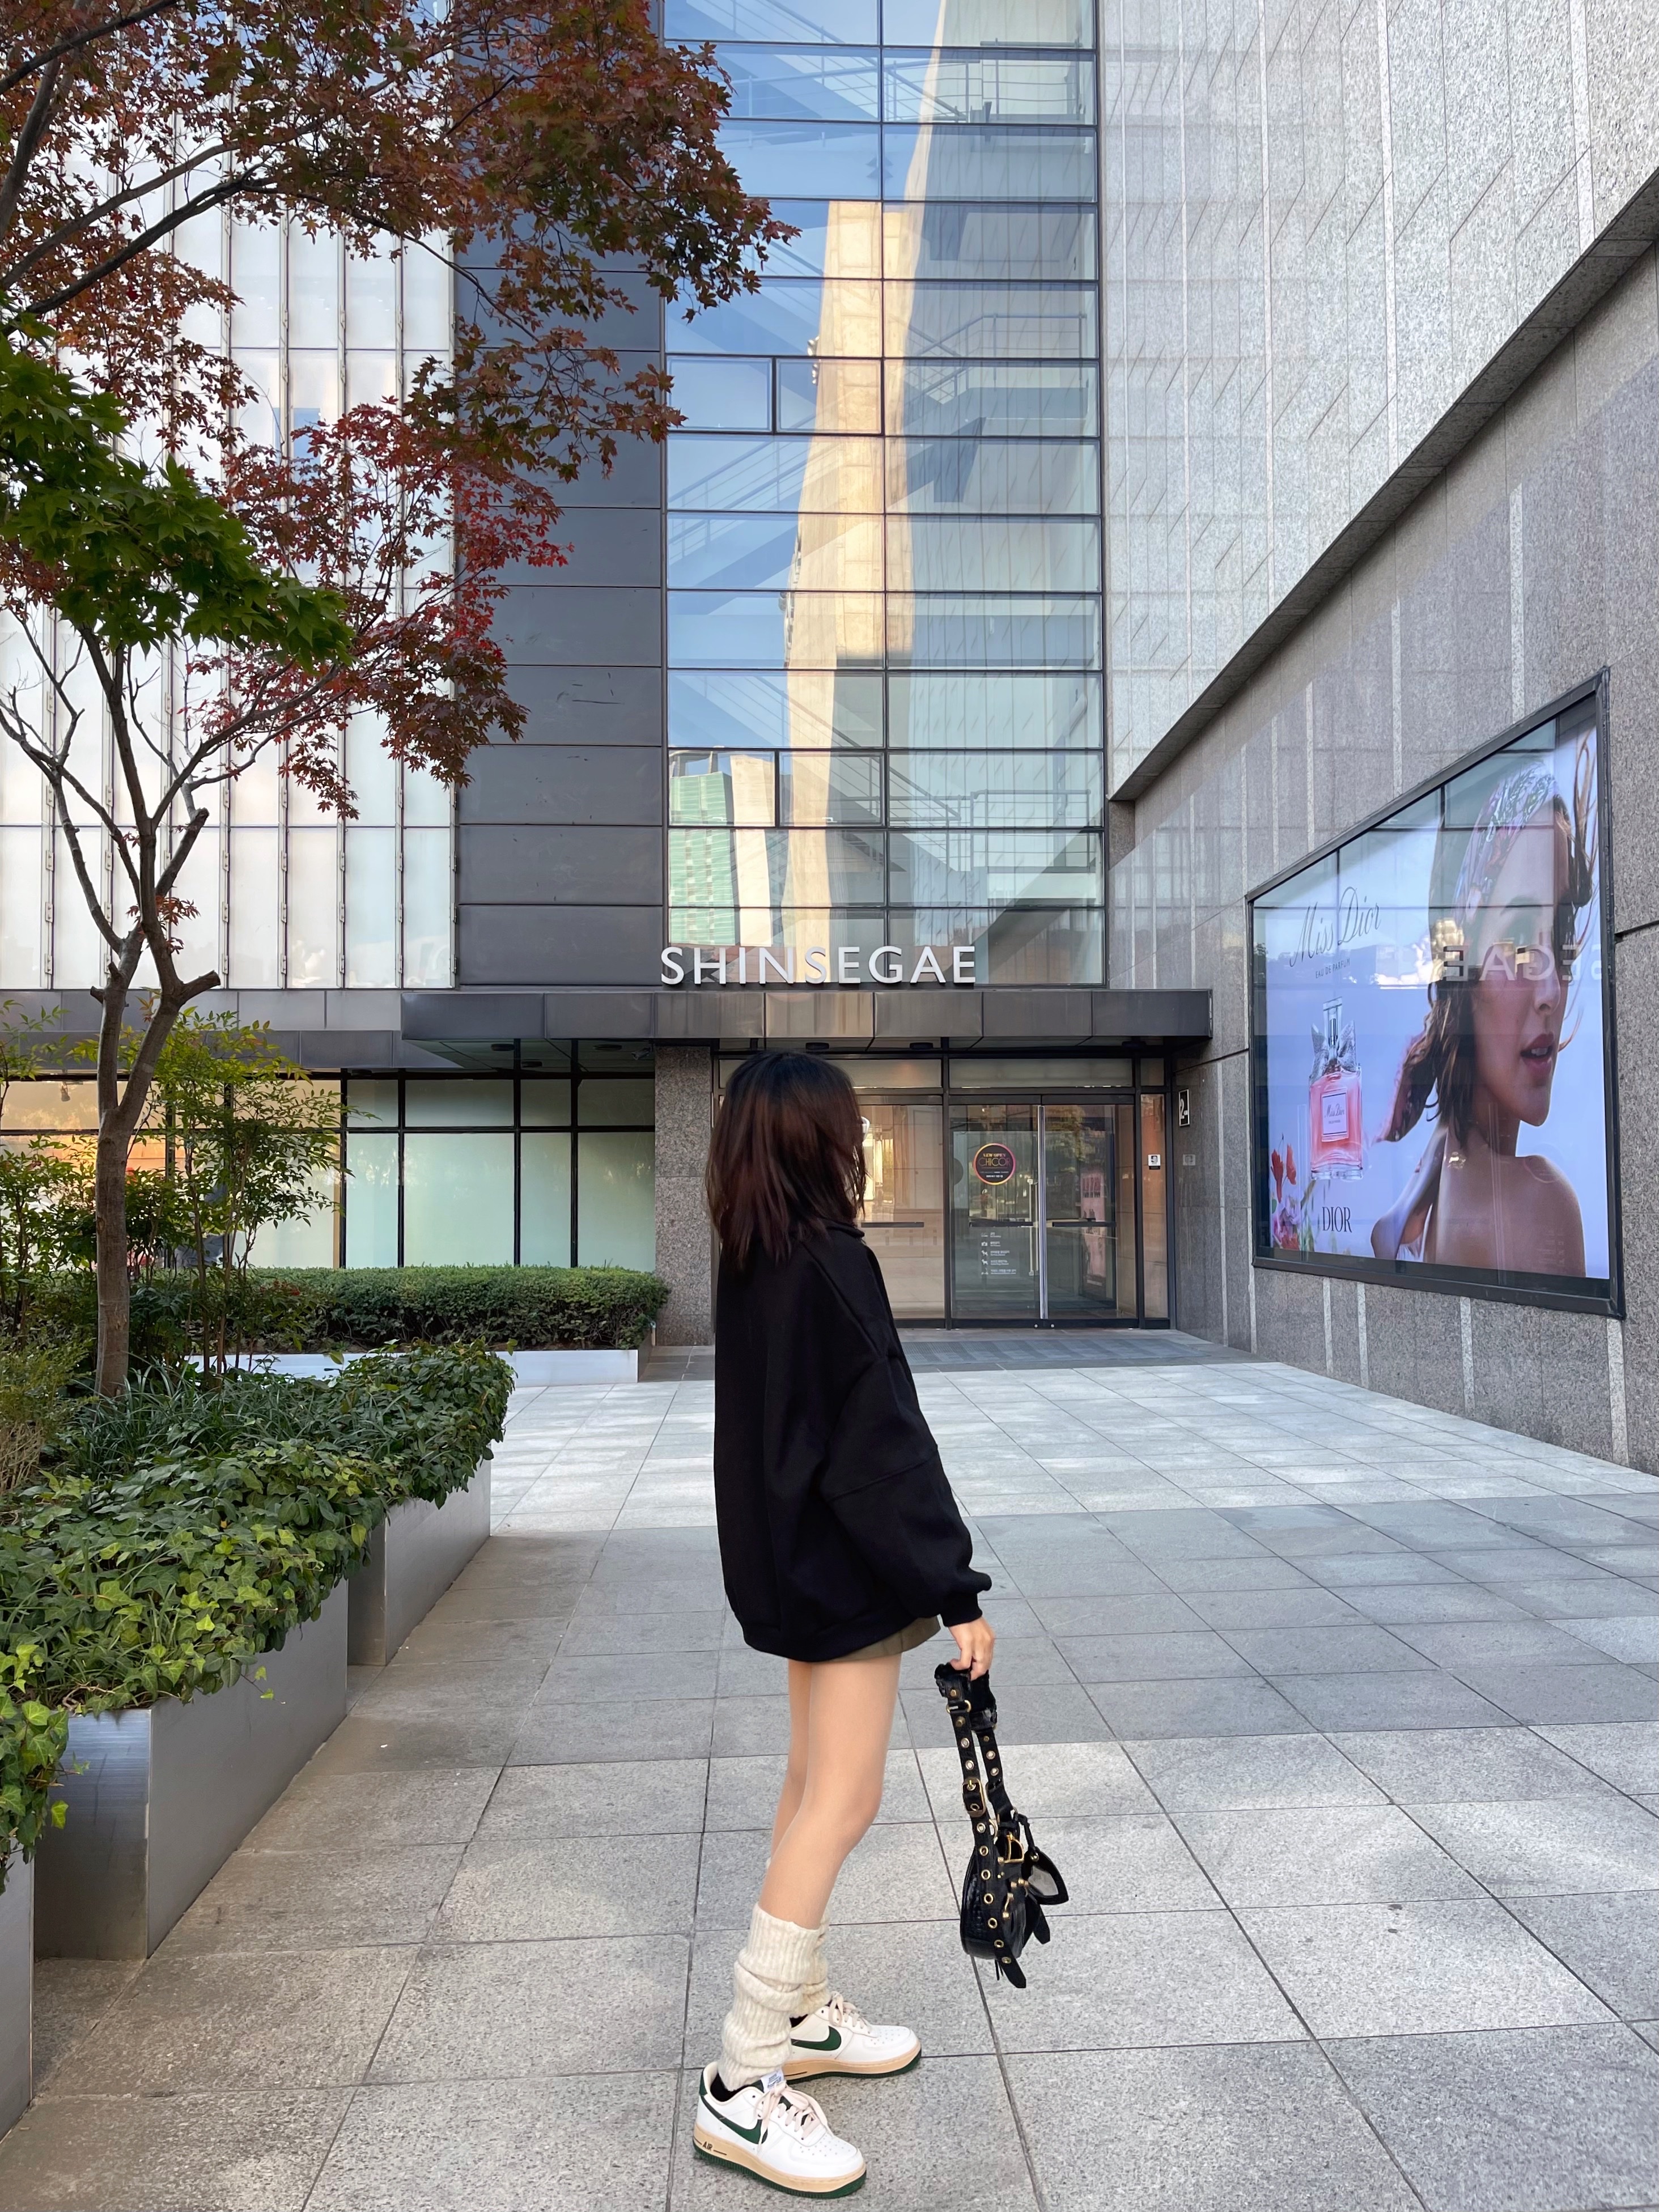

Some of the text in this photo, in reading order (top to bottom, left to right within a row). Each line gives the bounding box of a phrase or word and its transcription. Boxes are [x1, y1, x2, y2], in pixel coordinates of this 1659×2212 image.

[1289, 886, 1381, 967] Miss Dior
[660, 945, 976, 985] SHINSEGAE
[1316, 958, 1350, 979] EAU DE PARFUM
[978, 1157, 1010, 1166] CHICOR
[1322, 1206, 1352, 1233] DIOR
[702, 2141, 712, 2151] AIR
